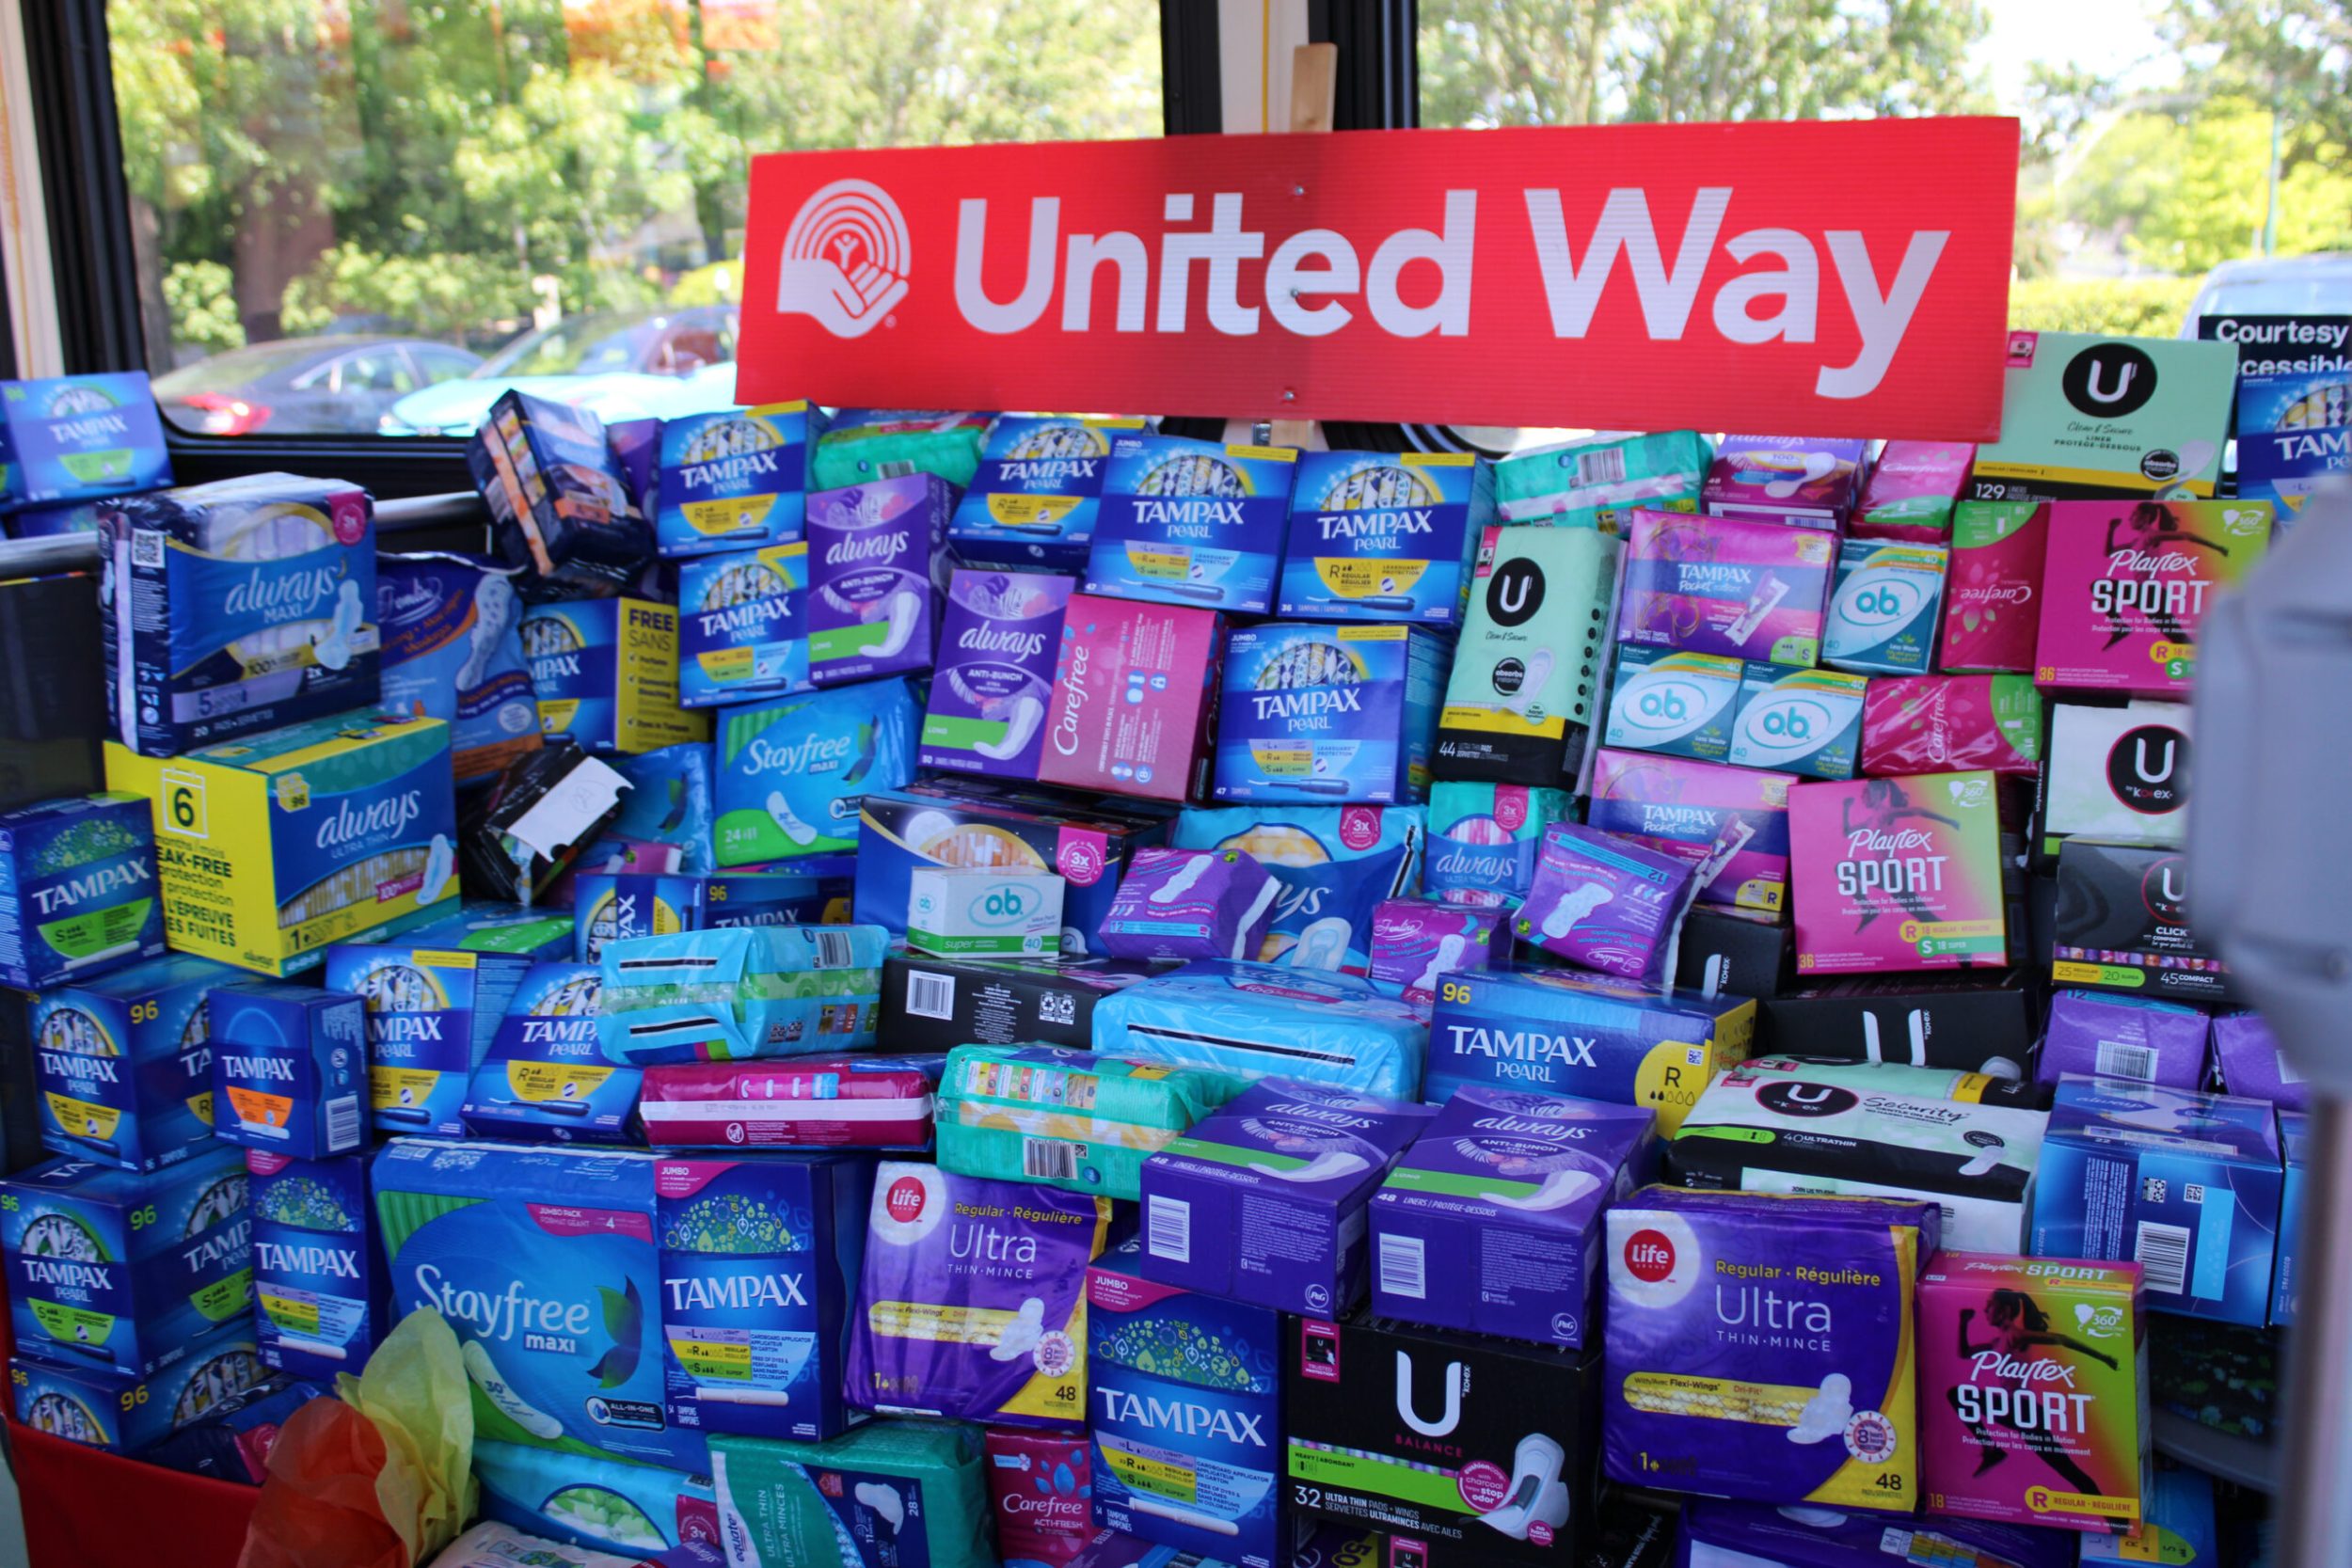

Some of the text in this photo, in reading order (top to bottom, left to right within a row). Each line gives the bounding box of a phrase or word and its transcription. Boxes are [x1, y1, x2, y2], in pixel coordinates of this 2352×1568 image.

[953, 186, 1952, 399] United Way
[2216, 319, 2349, 349] Courtesy
[2087, 359, 2133, 404] U
[48, 413, 129, 446] TAMPAX
[678, 451, 778, 489] TAMPAX
[998, 460, 1098, 482] TAMPAX
[1976, 483, 2006, 499] 129
[1132, 501, 1245, 525] TAMPAX
[1167, 525, 1213, 539] PEARL
[1317, 510, 1433, 541] TAMPAX
[826, 531, 910, 565] always
[1354, 536, 1401, 552] PEARL
[1678, 563, 1752, 585] TAMPAX
[2106, 549, 2199, 579] Playtex
[224, 561, 338, 620] always
[840, 573, 895, 590] ANTI-BUNCH
[1678, 578, 1711, 593] Pocket
[1501, 575, 1530, 613] U
[1855, 586, 1900, 617] o.b.
[1961, 586, 2032, 605] Carefree
[2091, 579, 2209, 614] SPORT
[263, 604, 303, 625] MAXI
[628, 608, 675, 632] FREE
[698, 595, 792, 638] TAMPAX
[628, 629, 672, 652] SANS
[959, 621, 1046, 662] always
[1231, 633, 1257, 642] JUMBO
[967, 668, 1023, 682] ANTI-BUNCH
[1851, 679, 1865, 690] 40
[2039, 667, 2055, 682] 36
[1054, 644, 1089, 756] Carefree
[1251, 687, 1362, 721] TAMPAX
[1640, 689, 1687, 721] o.b.
[1288, 717, 1332, 733] PEARL
[1763, 706, 1811, 740] o.b.
[1927, 681, 1951, 764] Carefree
[742, 733, 850, 777] Stayfree
[1438, 741, 1455, 756] 44
[808, 759, 838, 775] maxi
[2136, 737, 2174, 784] U
[173, 787, 196, 827] 6
[316, 788, 421, 848] always
[1642, 803, 1717, 827] TAMPAX
[724, 829, 741, 844] 24
[1353, 819, 1371, 832] 3x
[1643, 820, 1676, 834] Pocket
[1848, 829, 1932, 858] Playtex
[1435, 847, 1518, 885] always
[1837, 856, 1946, 895] SPORT
[31, 855, 152, 916] TAMPAX
[167, 882, 233, 907] protection
[709, 885, 727, 901] 96
[985, 888, 1024, 916] o.b.
[188, 922, 236, 947] FUITES
[2155, 927, 2187, 937] CLICK
[945, 939, 975, 950] super
[1025, 938, 1041, 950] 40
[1799, 954, 1814, 969] 36
[2161, 973, 2214, 984] 45 COMPACT
[1442, 983, 1471, 1005] 96
[129, 1001, 159, 1024] 96
[548, 1042, 594, 1055] PEARL
[1447, 1025, 1597, 1069] TAMPAX
[40, 1052, 119, 1084] TAMPAX
[221, 1054, 294, 1082] TAMPAX
[1495, 1061, 1556, 1084] PEARL
[1664, 1068, 1681, 1087] R
[1787, 1084, 1833, 1103] U
[1265, 1100, 1379, 1130] always
[1863, 1097, 1966, 1121] Security
[1266, 1118, 1340, 1137] ANTI-BUNCH
[1472, 1116, 1593, 1141] always
[1481, 1138, 1559, 1153] ANTI-BUNCH
[1804, 1135, 1857, 1148] ULTRATHIN
[660, 1166, 690, 1176] JUMBO
[1151, 1155, 1199, 1172] 48 LINERS
[1, 1195, 20, 1212] 96
[891, 1189, 921, 1208] Life
[1377, 1192, 1427, 1208] 48 LINERS
[130, 1204, 157, 1230] 96
[953, 1202, 1083, 1226] Regular Régulière
[949, 1224, 1037, 1262] Ultra
[1631, 1243, 1669, 1264] Life
[255, 1242, 360, 1278] TAMPAX
[1964, 1262, 2107, 1279] Playtex SPORT
[22, 1259, 112, 1291] TAMPAX
[1094, 1275, 1128, 1291] JUMBO
[1715, 1260, 1882, 1287] Regular Régulière
[414, 1263, 589, 1341] Stayfree
[664, 1273, 807, 1310] TAMPAX
[1715, 1285, 1832, 1333] Ultra
[1556, 1318, 1575, 1330] P&G
[524, 1333, 576, 1354] maxi
[11, 1367, 29, 1387] 96
[1971, 1351, 2076, 1387] Playtex
[1055, 1386, 1076, 1402] 48
[1396, 1350, 1461, 1438] U
[1669, 1379, 1718, 1391] Flexi-Wings
[119, 1385, 150, 1411] 96
[610, 1402, 656, 1416] ALL-IN-ONE
[1957, 1384, 2093, 1434] SPORT
[1095, 1386, 1266, 1448] TAMPAX
[1394, 1433, 1463, 1459] BALANCE
[1962, 1436, 1994, 1447] Protection
[1996, 1439, 2010, 1449] pour
[2012, 1440, 2023, 1449] les
[2054, 1446, 2090, 1456] mouvement
[1976, 1428, 2009, 1438] Protection
[2010, 1430, 2020, 1439] for
[2021, 1432, 2042, 1442] Bodies
[2053, 1434, 2076, 1445] Motion
[1295, 1452, 1355, 1468] HEAVY ABONDANT
[1466, 1477, 1503, 1490] charcoal
[1481, 1487, 1503, 1498] stop
[1875, 1473, 1903, 1491] 48
[775, 1483, 787, 1530] MINCES
[908, 1501, 919, 1517] 28
[1003, 1492, 1083, 1516] Carefree
[1294, 1485, 1420, 1520] 32 ULTRA THIN PADS WINGS
[1472, 1494, 1494, 1504] odor
[1929, 1493, 1945, 1508] 18
[2031, 1491, 2048, 1507] R
[2053, 1497, 2086, 1508] REGULAR
[757, 1489, 776, 1558] ULTRA THIN
[1034, 1518, 1084, 1528] ACTI-FRESH
[1325, 1502, 1462, 1539] SERVIETTES ULTRAMINCES AVEC AILES
[727, 1516, 745, 1563] equate
[1531, 1528, 1550, 1537] harsh
